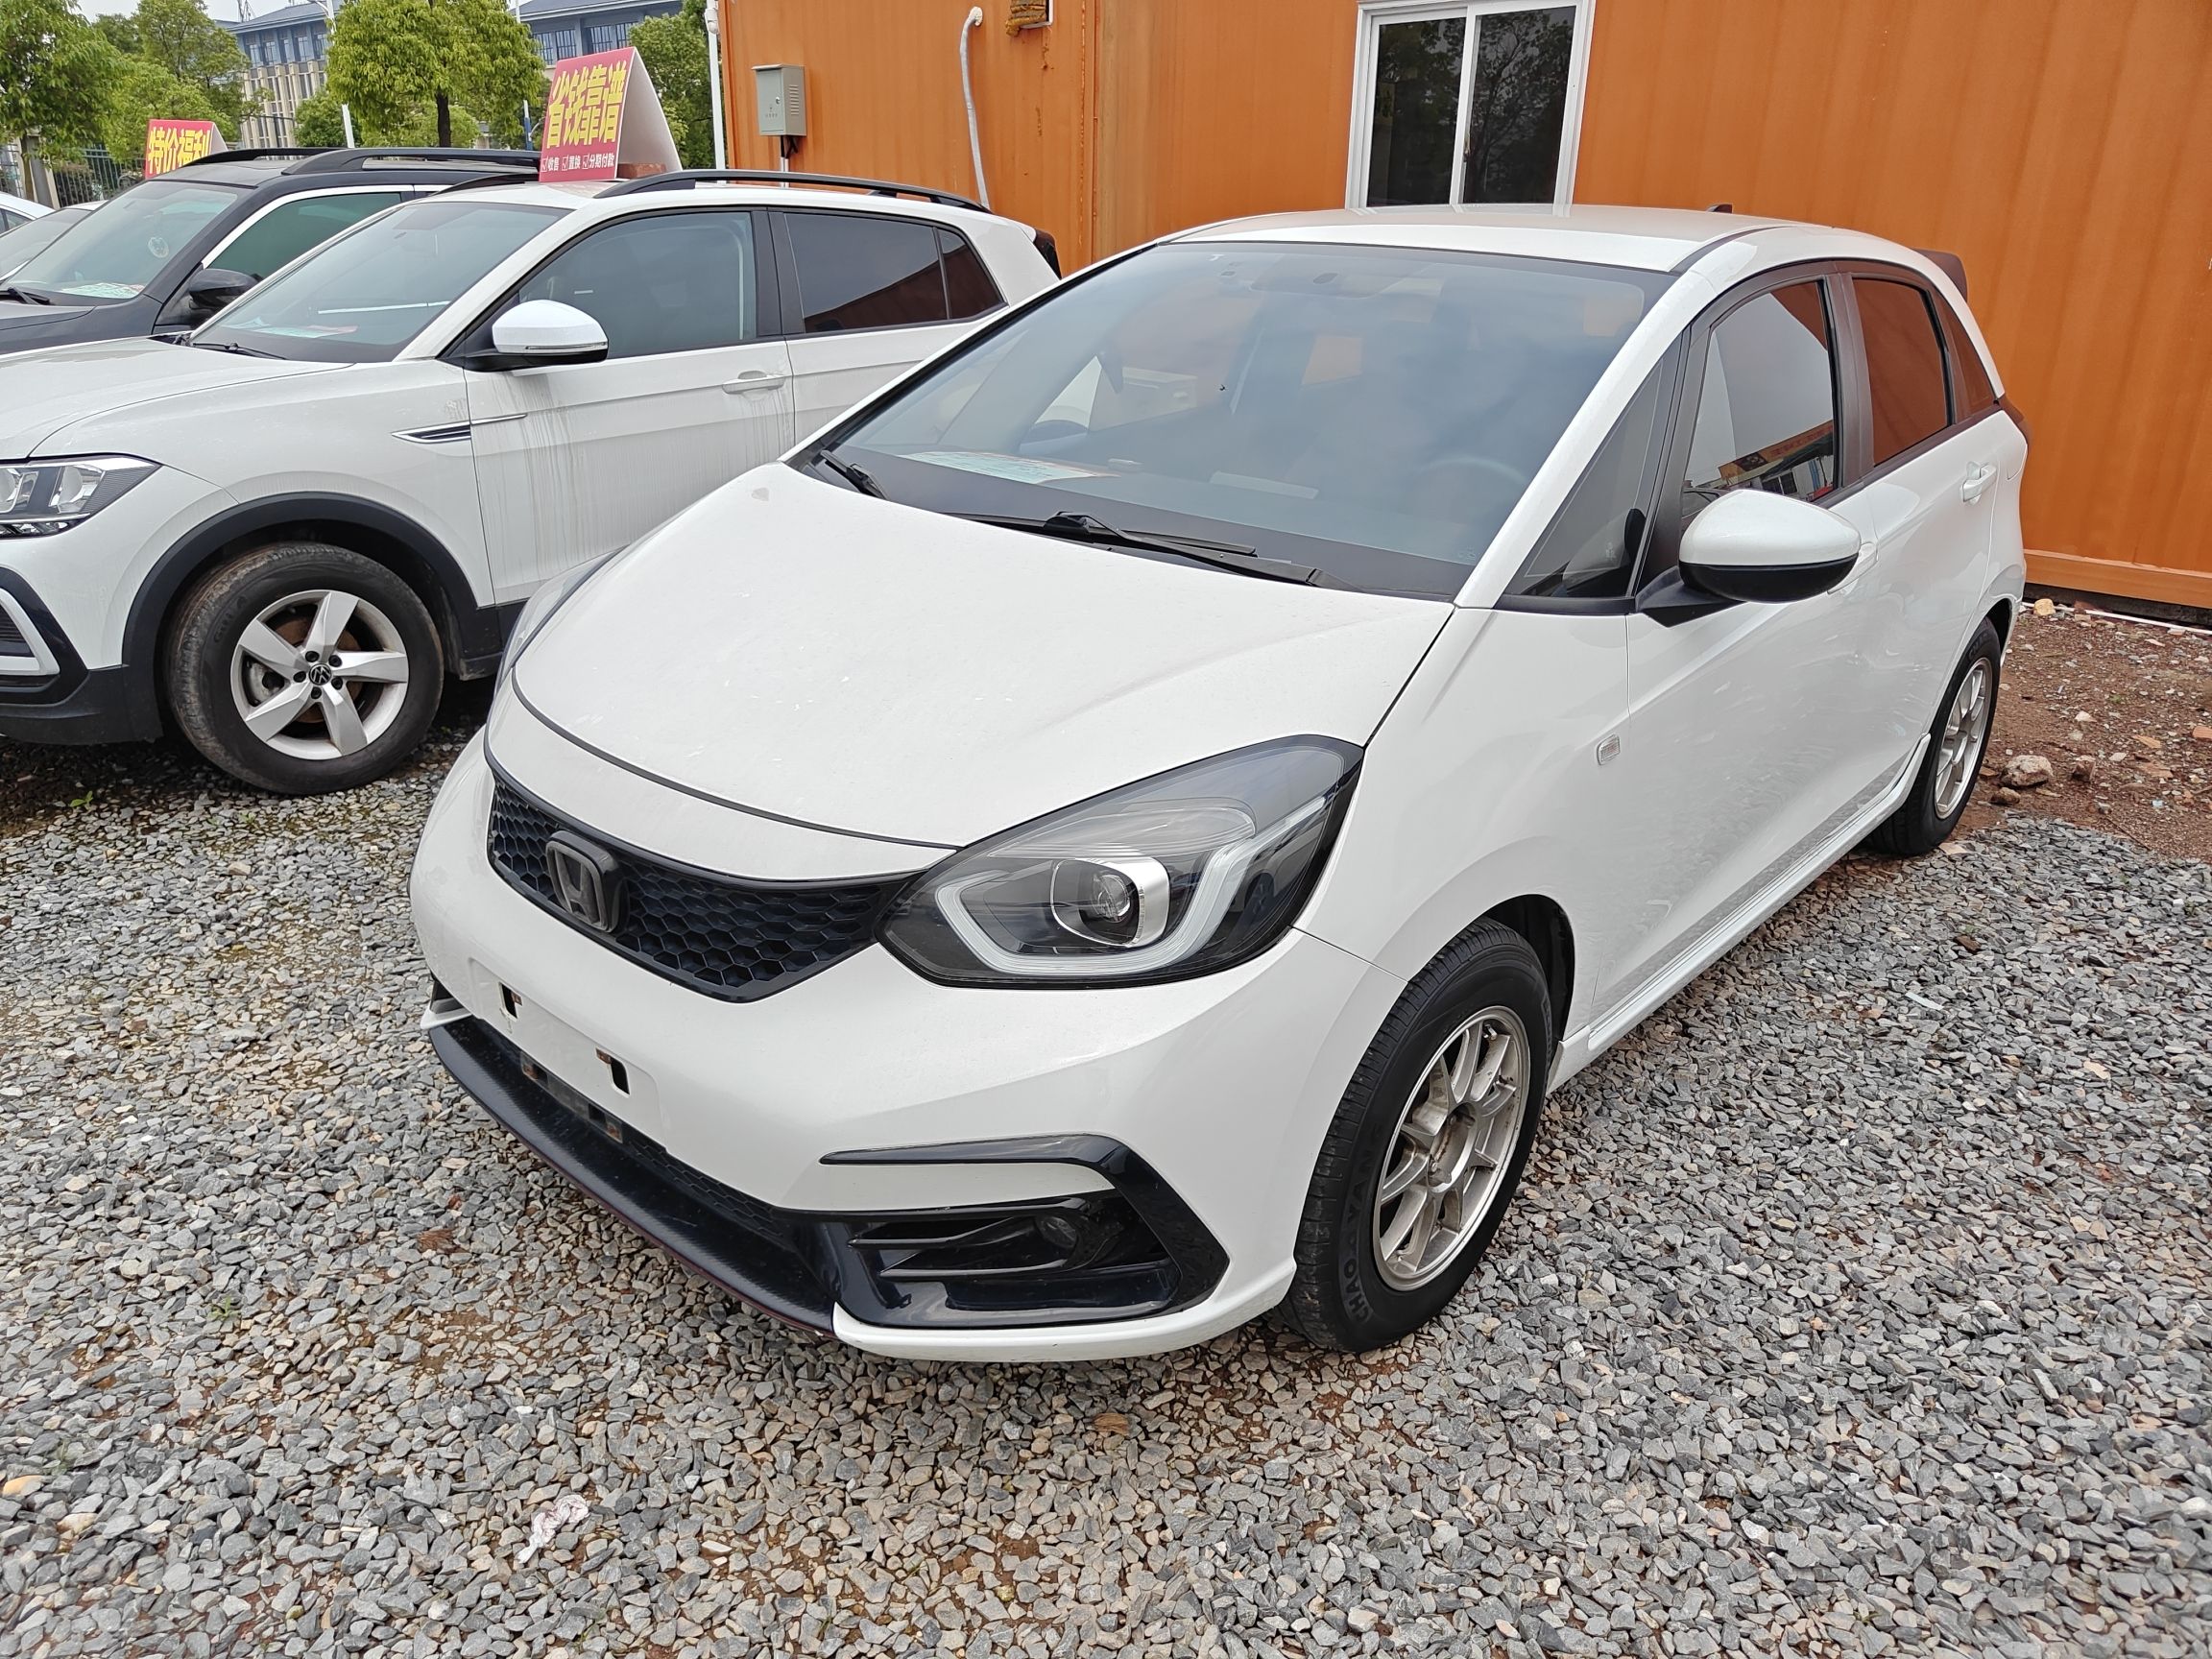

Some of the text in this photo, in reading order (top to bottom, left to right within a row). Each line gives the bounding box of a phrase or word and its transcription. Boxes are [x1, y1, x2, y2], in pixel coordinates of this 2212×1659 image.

[546, 60, 627, 149] 省钱靠谱
[147, 126, 210, 174] 特价福利
[589, 153, 614, 168] 分期付款
